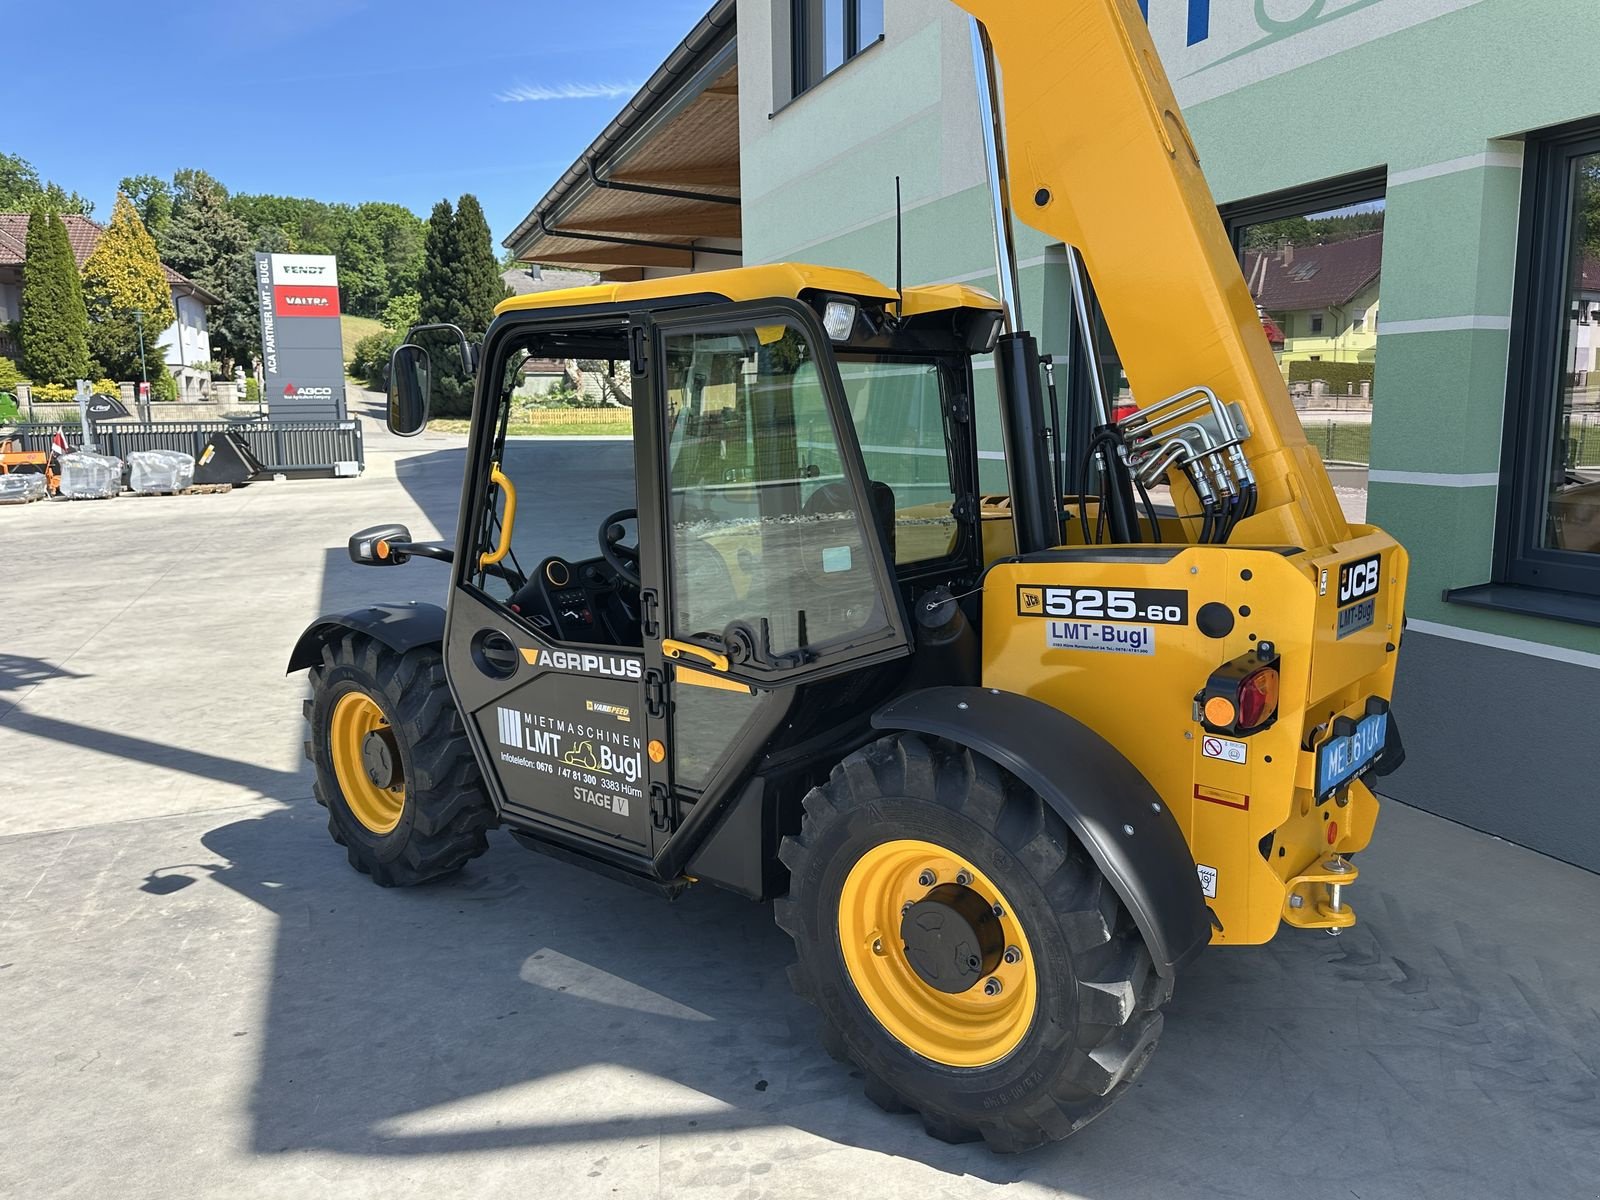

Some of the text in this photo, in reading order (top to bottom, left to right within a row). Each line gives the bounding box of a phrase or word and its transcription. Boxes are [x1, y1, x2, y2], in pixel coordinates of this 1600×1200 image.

[260, 258, 270, 284] BUGL
[283, 265, 327, 275] FENDT
[262, 290, 273, 310] LMT
[285, 296, 329, 306] VALTRA
[264, 311, 275, 353] PARTNER
[297, 387, 332, 395] AGCO
[1341, 559, 1379, 602] JCB
[1045, 588, 1182, 623] 525-60
[1052, 622, 1149, 648] LMT-Bugl
[539, 650, 642, 678] AGRIPLUS
[524, 713, 641, 749] MIETMASCHINEN
[525, 728, 642, 782] LMT Bugl
[500, 752, 536, 769] Infotelefon:
[536, 761, 554, 774] 0676
[562, 767, 572, 779] 47
[572, 771, 582, 782] 81
[583, 774, 597, 786] 300
[601, 778, 620, 792] 3383
[621, 783, 643, 799] Hürm
[573, 786, 612, 810] STAGE
